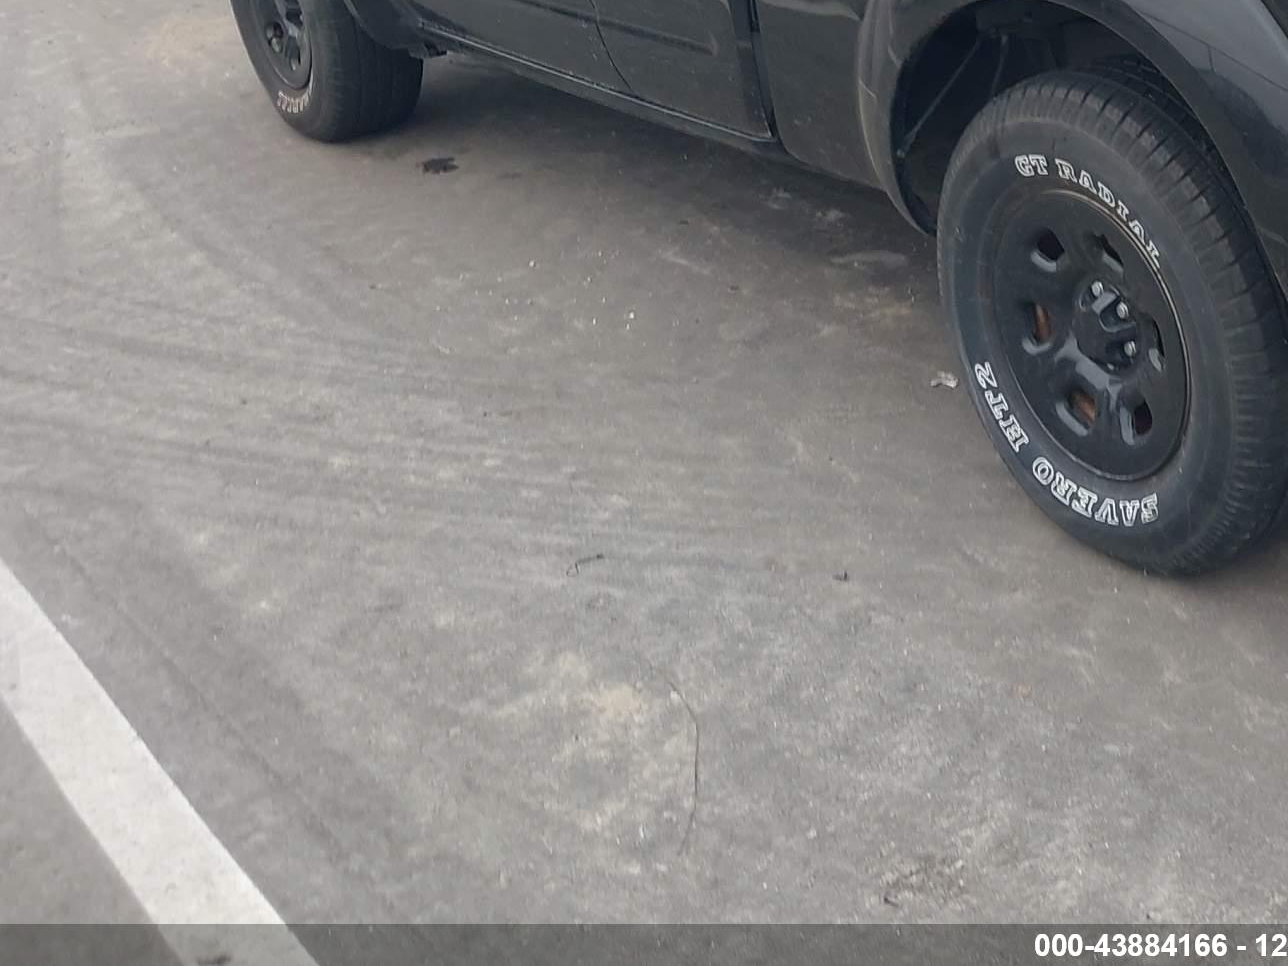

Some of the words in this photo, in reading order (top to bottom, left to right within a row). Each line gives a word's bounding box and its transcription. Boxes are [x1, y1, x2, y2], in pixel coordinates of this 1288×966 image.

[1014, 154, 1048, 177] GT
[1054, 157, 1161, 269] RADIAL
[1032, 456, 1159, 527] SAVERO
